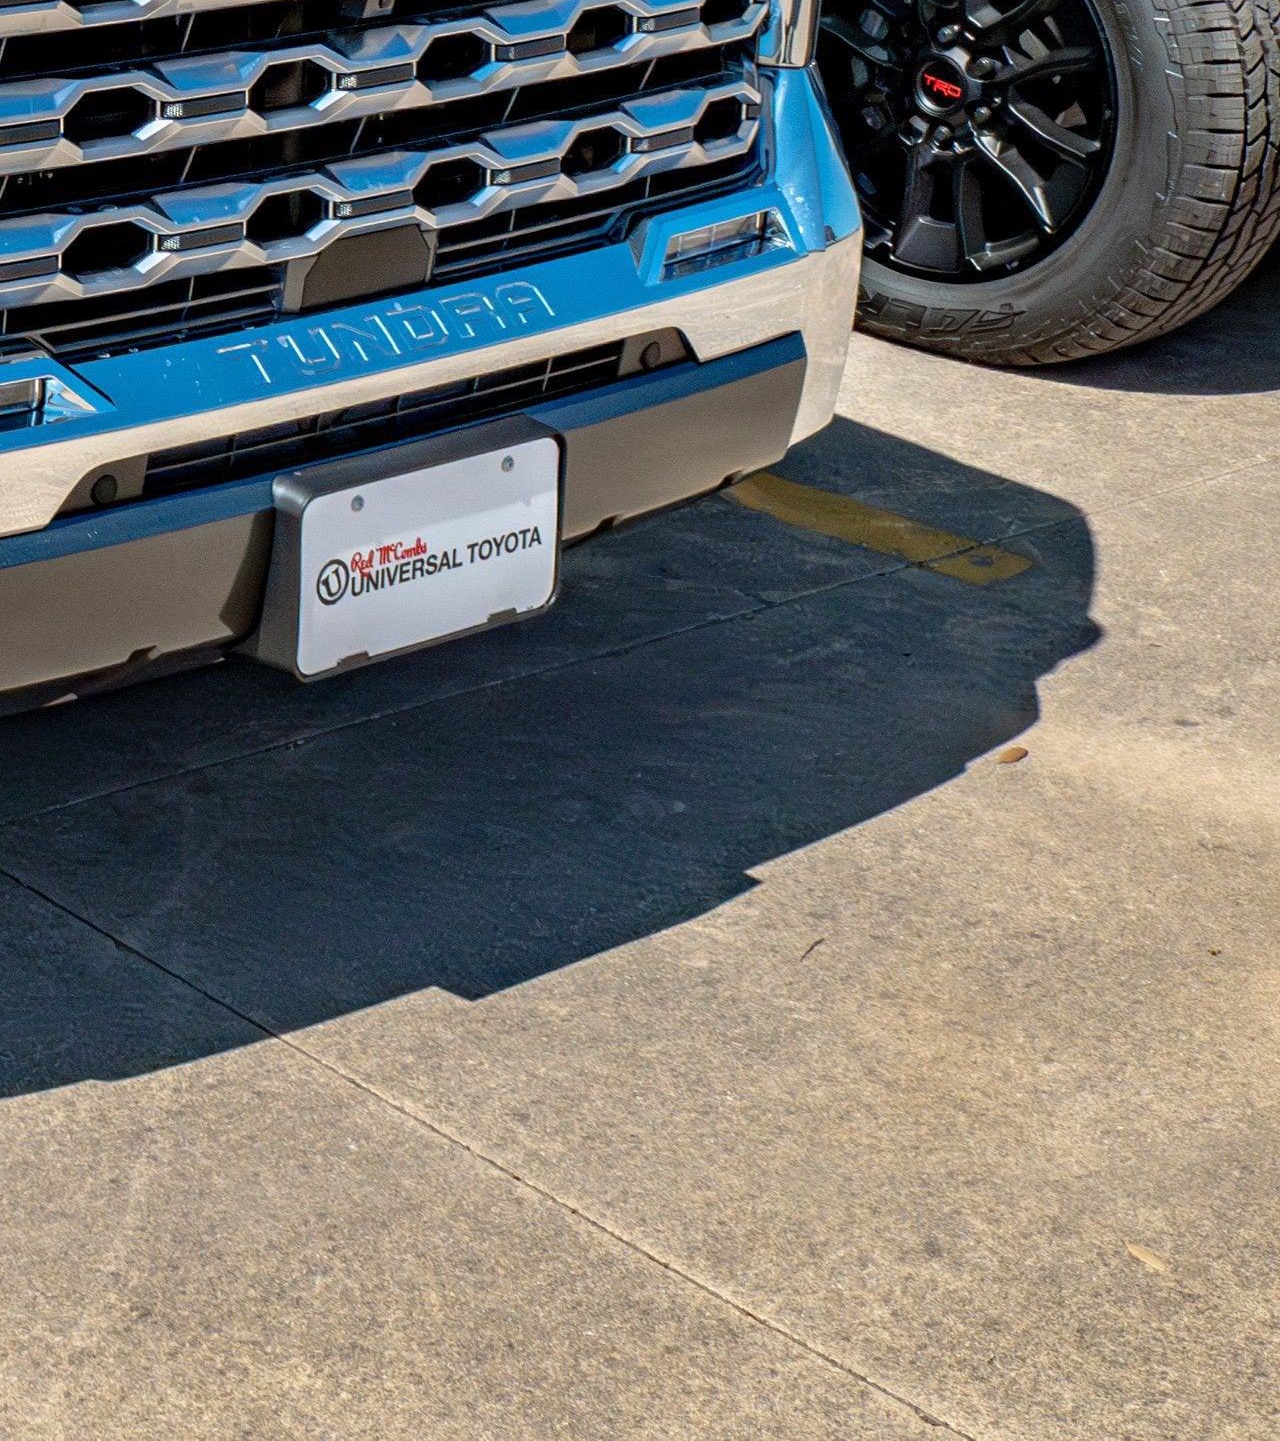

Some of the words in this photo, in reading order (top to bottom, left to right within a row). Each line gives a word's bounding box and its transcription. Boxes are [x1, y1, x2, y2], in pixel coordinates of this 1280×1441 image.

[923, 72, 962, 98] TRD
[215, 281, 556, 384] TUNDRA
[350, 549, 374, 577] Red
[375, 537, 428, 566] McCombs
[350, 548, 463, 597] UNIVERSAL
[467, 526, 542, 564] TOYOTA
